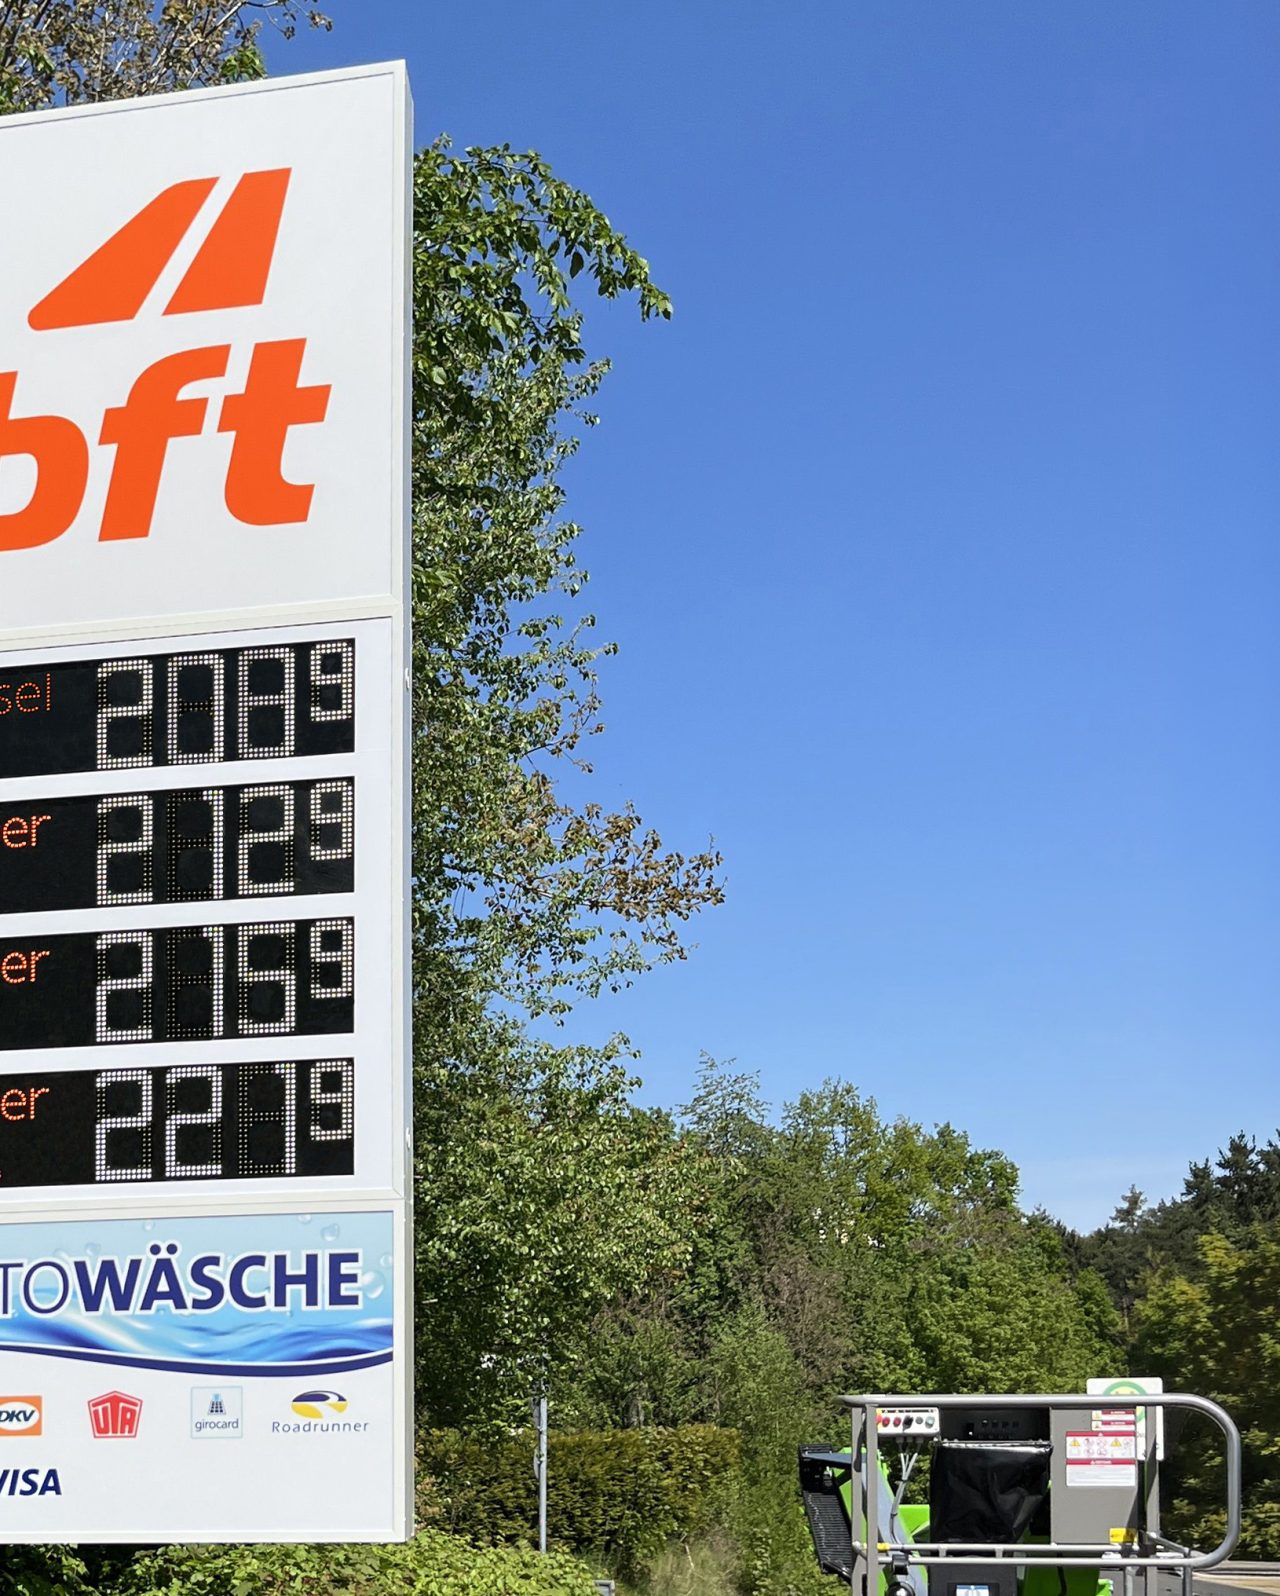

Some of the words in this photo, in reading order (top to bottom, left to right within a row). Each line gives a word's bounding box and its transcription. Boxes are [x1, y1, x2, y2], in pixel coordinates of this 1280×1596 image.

[91, 1394, 140, 1437] UTA
[194, 1418, 240, 1432] girocard
[271, 1420, 370, 1433] Roadrunner
